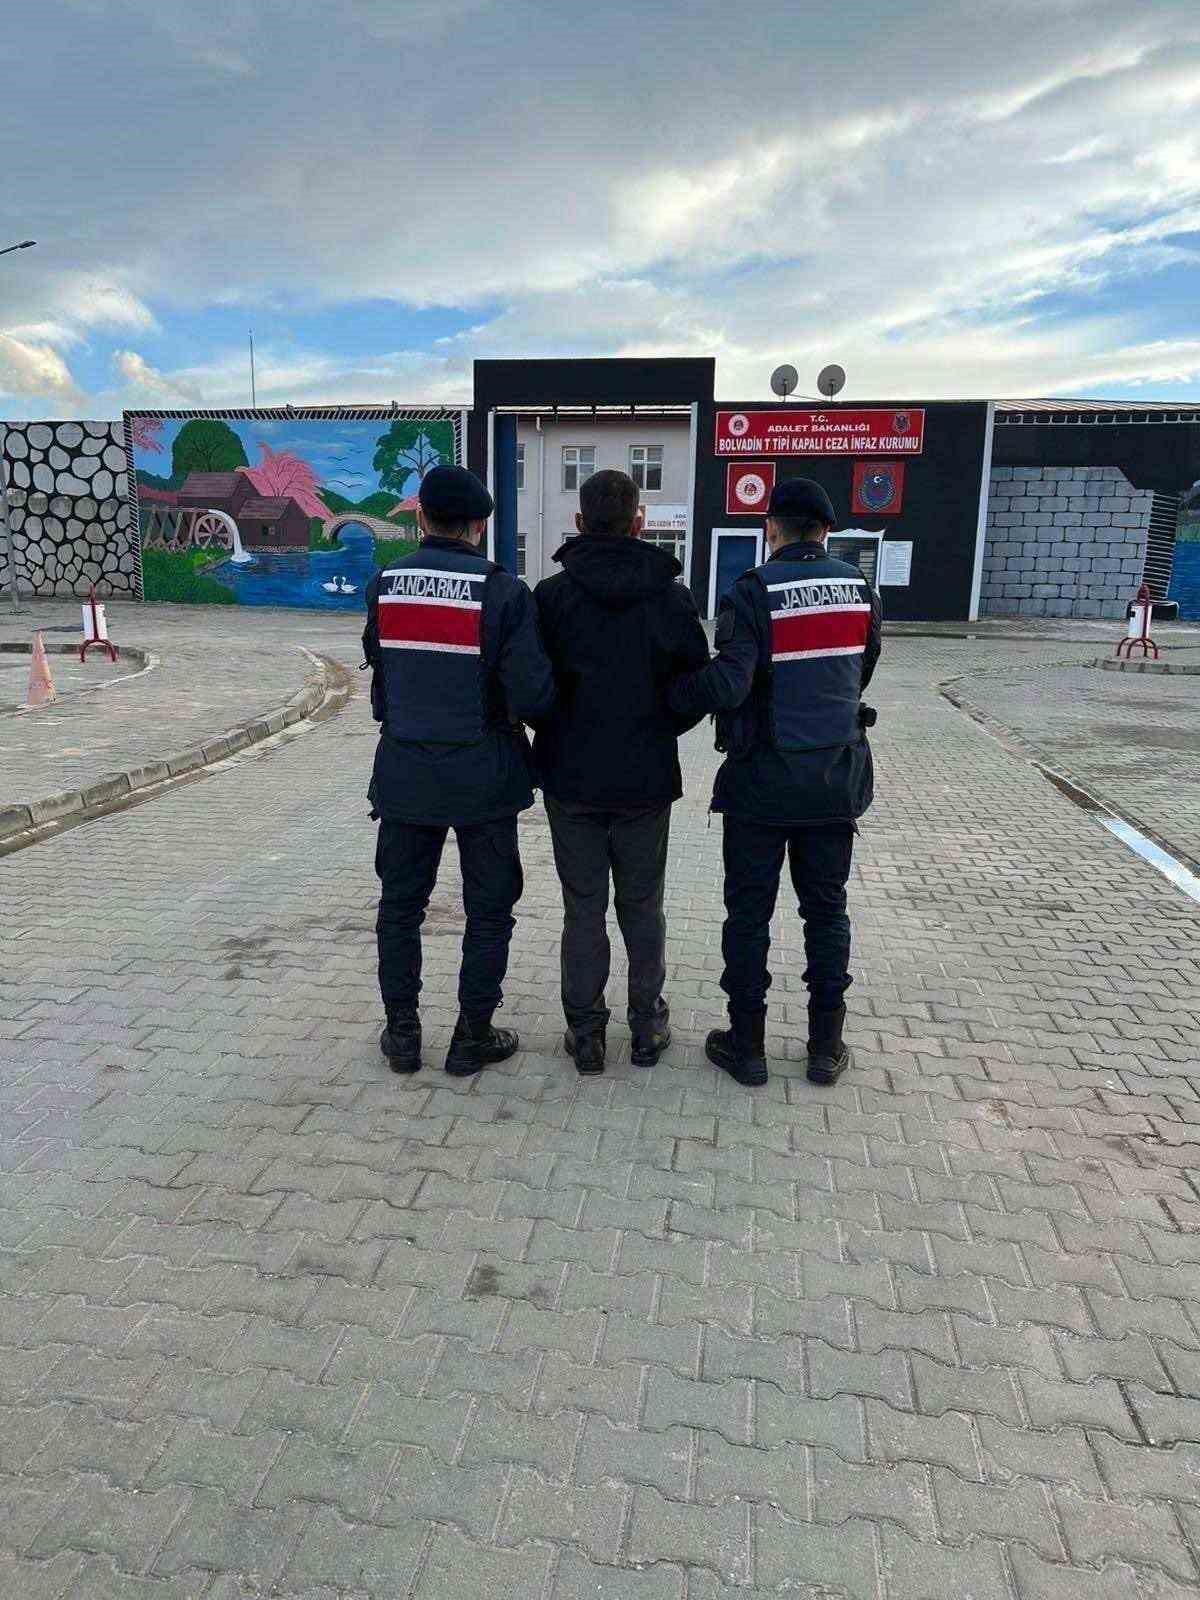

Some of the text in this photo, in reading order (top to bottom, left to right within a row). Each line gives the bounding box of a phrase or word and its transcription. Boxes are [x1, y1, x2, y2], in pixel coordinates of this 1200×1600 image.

[809, 415, 828, 423] T.C.
[811, 423, 870, 432] BAKANLIĞI
[719, 434, 919, 451] BOLVADİN T TİPİ KAPALI CEZA İNFAZ KURUMU
[387, 576, 473, 600] JANDARMA
[780, 585, 863, 609] JANDARMA
